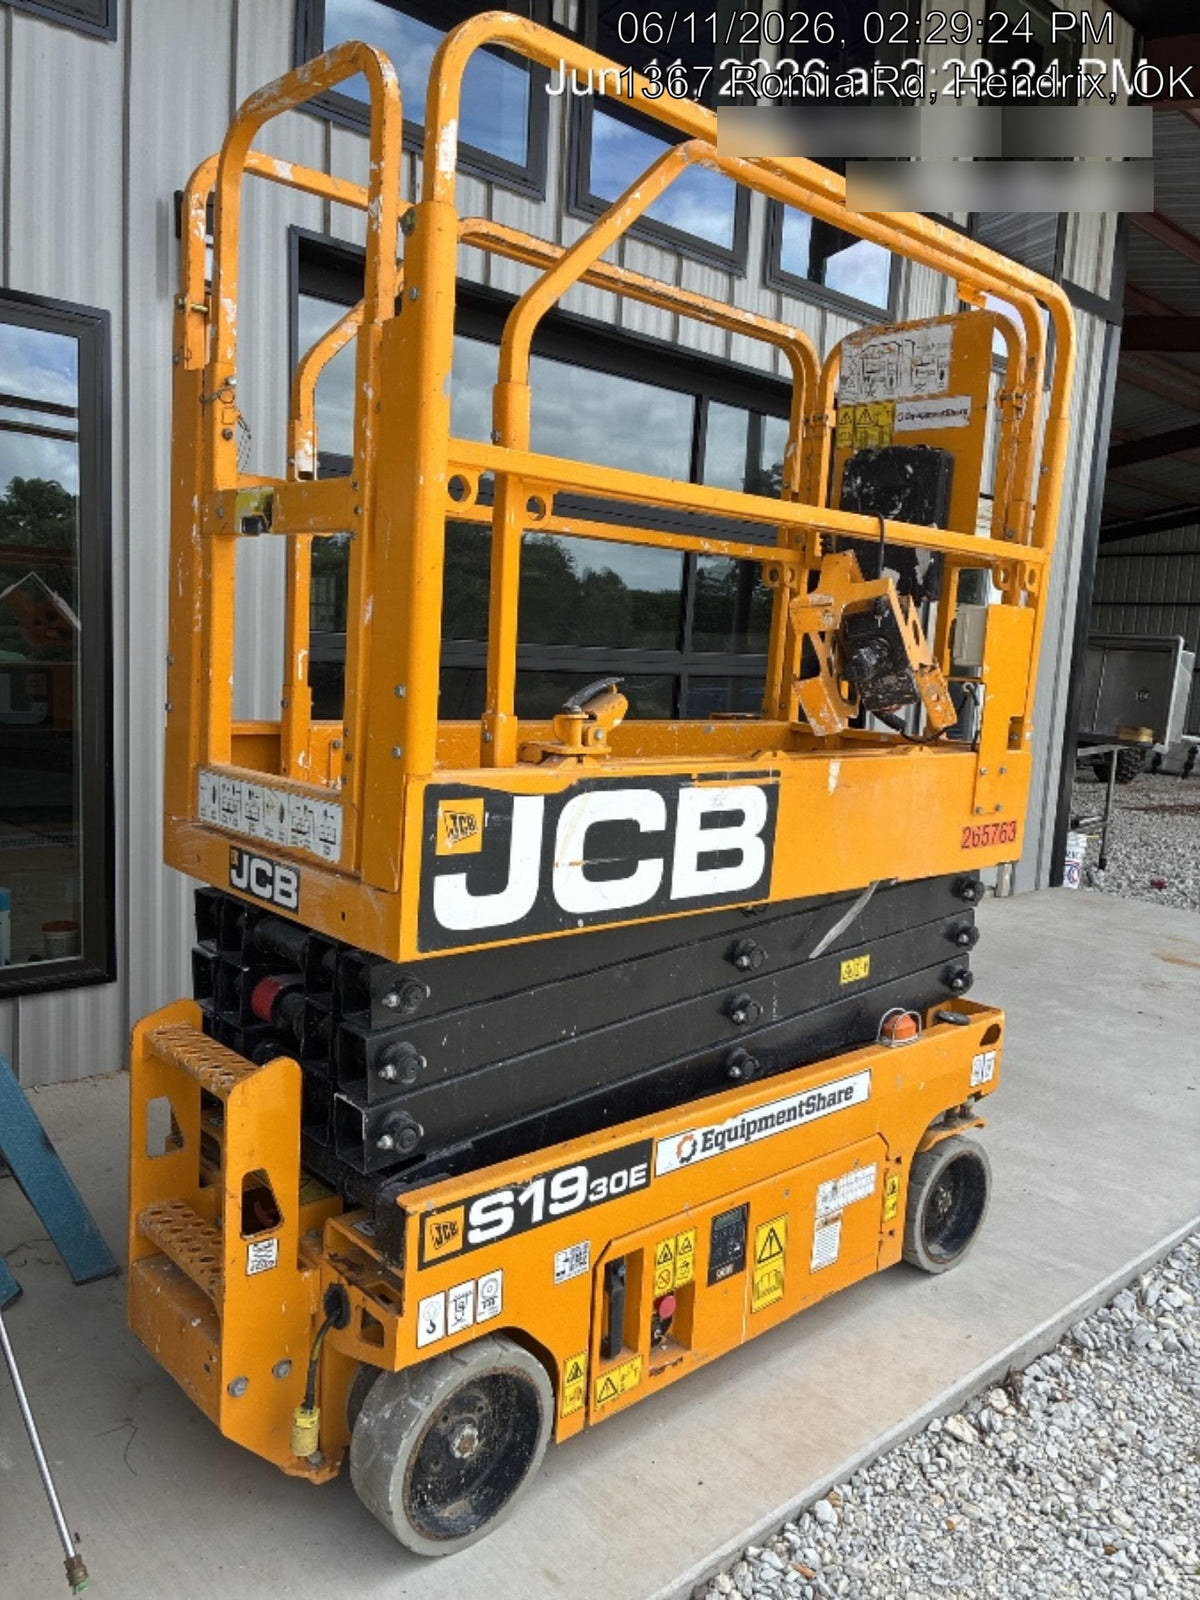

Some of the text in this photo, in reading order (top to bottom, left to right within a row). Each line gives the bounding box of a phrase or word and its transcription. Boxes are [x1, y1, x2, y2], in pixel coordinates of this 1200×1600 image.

[450, 811, 477, 839] JCB
[961, 820, 1017, 849] 265763
[432, 784, 769, 931] JCB
[230, 852, 299, 910] JCB
[701, 1085, 855, 1153] EquipmentShare
[434, 1221, 459, 1246] JCB
